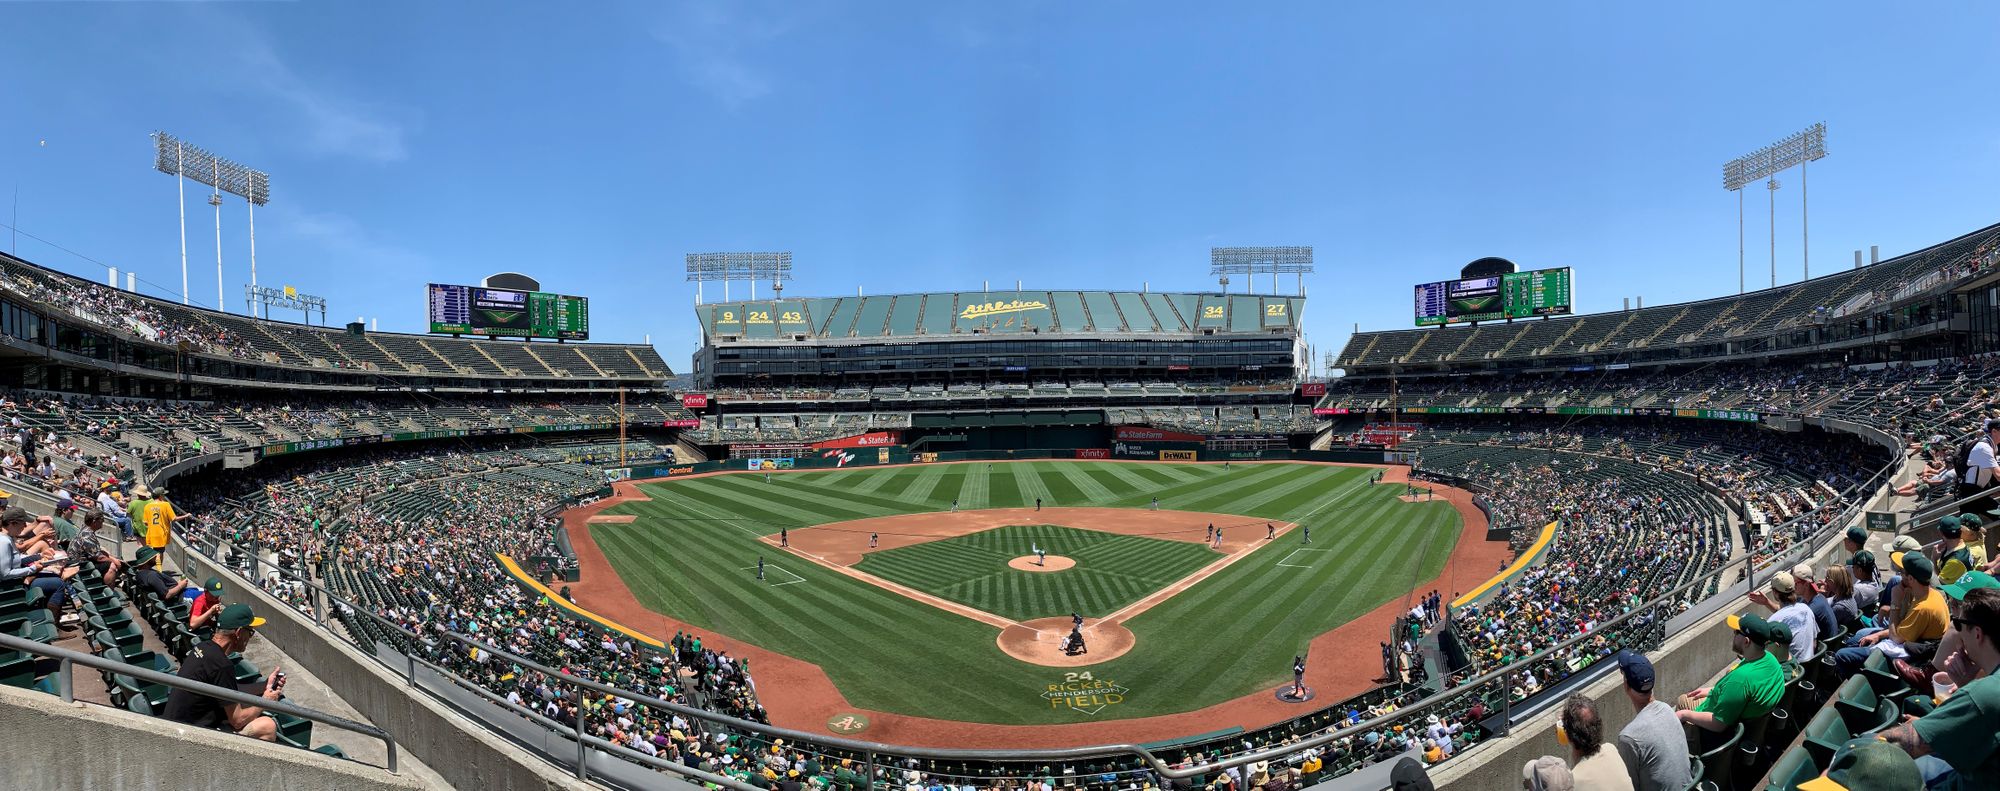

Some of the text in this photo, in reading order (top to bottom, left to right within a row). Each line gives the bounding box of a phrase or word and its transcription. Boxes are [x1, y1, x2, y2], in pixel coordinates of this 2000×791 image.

[960, 300, 1047, 319] Athletics
[1204, 306, 1224, 314] 34
[1267, 304, 1286, 312] 27
[723, 312, 734, 320] 9
[749, 312, 768, 320] 24
[782, 312, 802, 320] 43
[684, 396, 706, 405] xfinity
[1080, 450, 1105, 458] xfinity
[152, 512, 160, 524] 2
[1064, 671, 1093, 682] 24
[1048, 680, 1114, 692] RICKEY
[1049, 688, 1120, 697] HENDERSON
[1051, 694, 1124, 708] FIELD
[829, 716, 864, 730] A's
